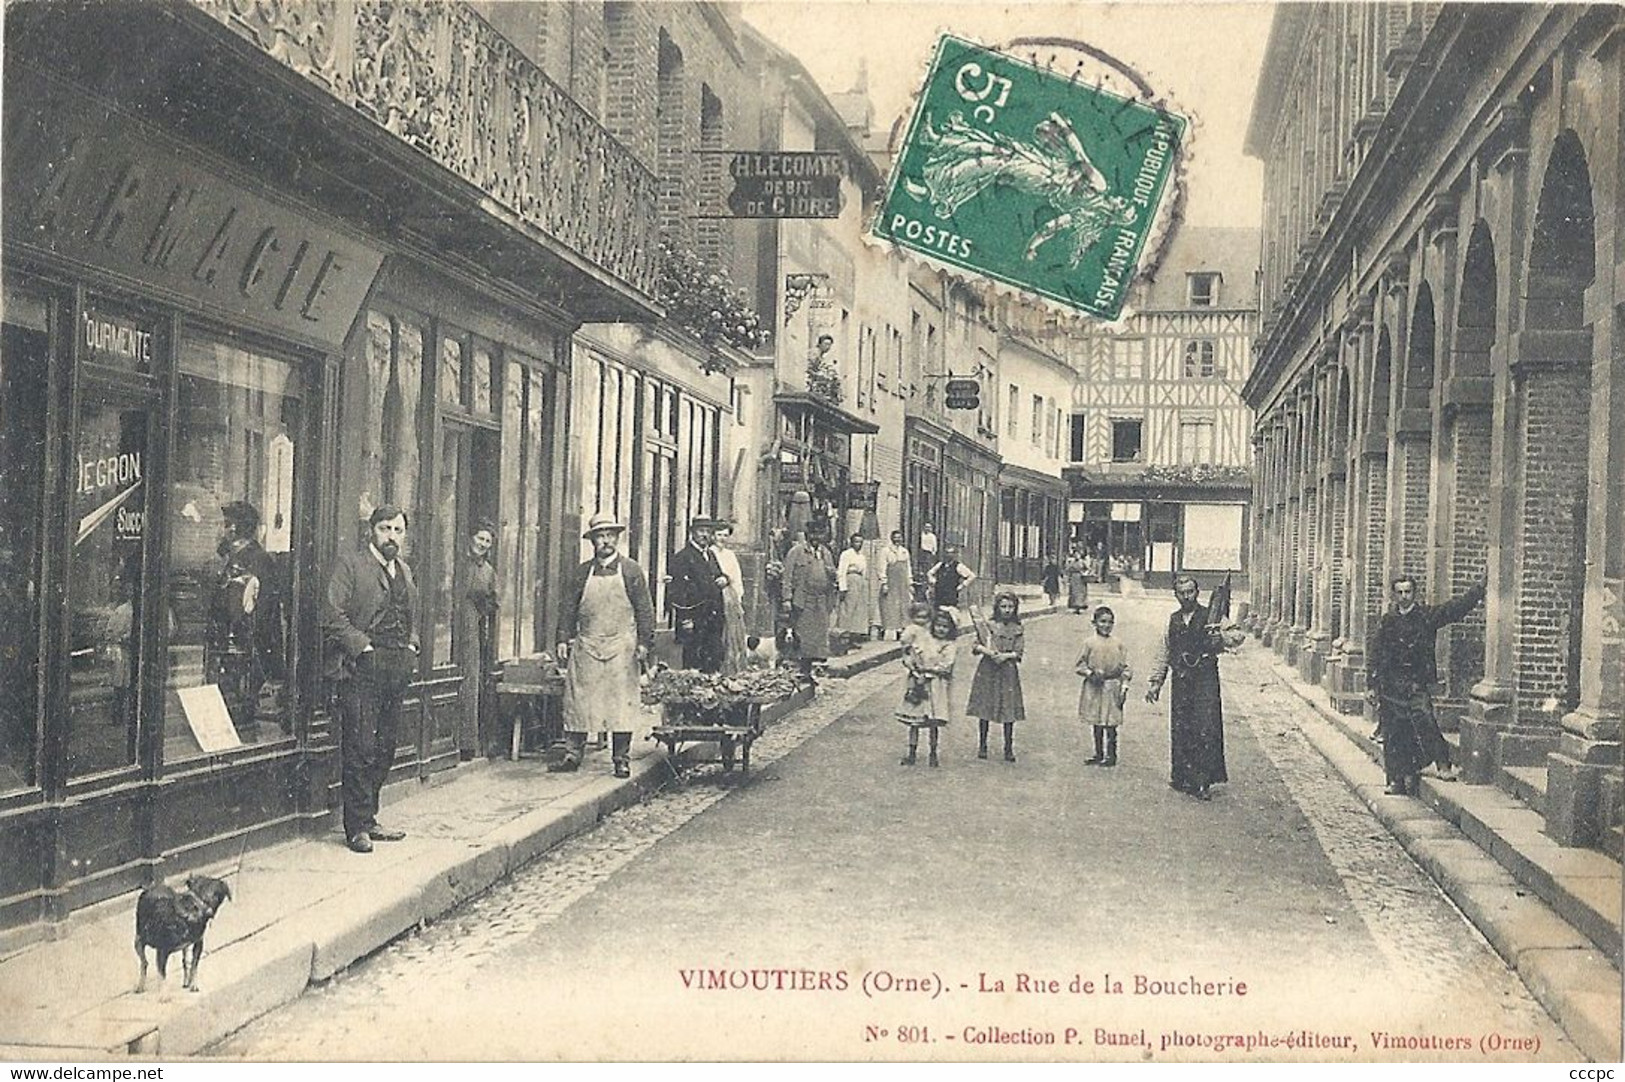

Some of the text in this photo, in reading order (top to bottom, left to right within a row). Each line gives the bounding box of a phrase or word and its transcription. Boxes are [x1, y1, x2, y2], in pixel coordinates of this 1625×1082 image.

[764, 180, 812, 196] DEBIT
[747, 196, 835, 216] DE CIDRE
[890, 214, 974, 258] POSTES
[83, 311, 150, 361] OURMENTE
